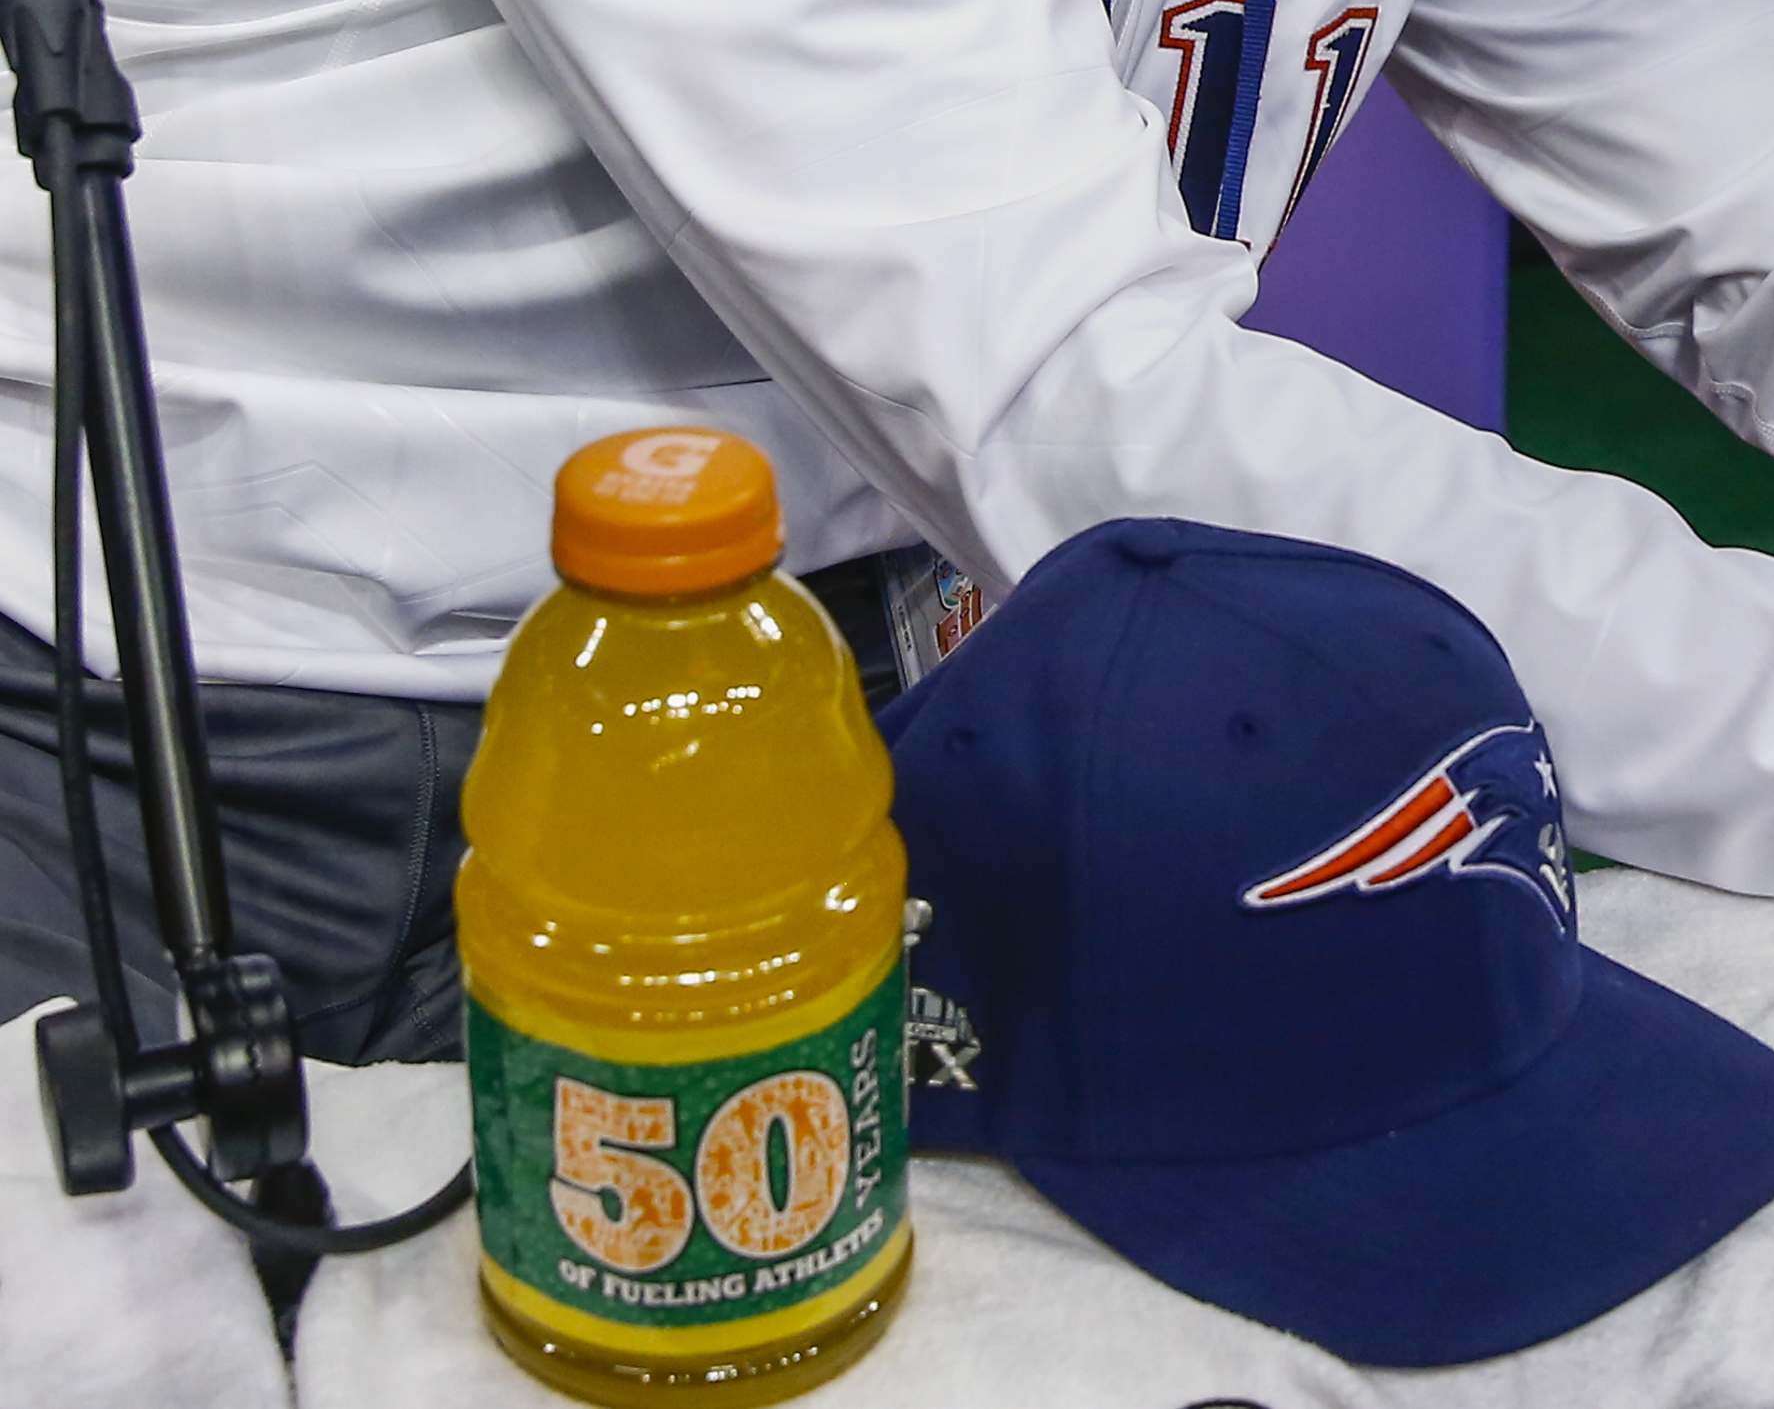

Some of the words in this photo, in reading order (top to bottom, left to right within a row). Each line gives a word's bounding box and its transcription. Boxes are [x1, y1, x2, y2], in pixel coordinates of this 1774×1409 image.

[622, 433, 721, 477] G
[549, 1069, 850, 1274] 50
[851, 1028, 882, 1210] YEARS
[558, 1258, 597, 1290] OF
[601, 1271, 747, 1307] FUELING
